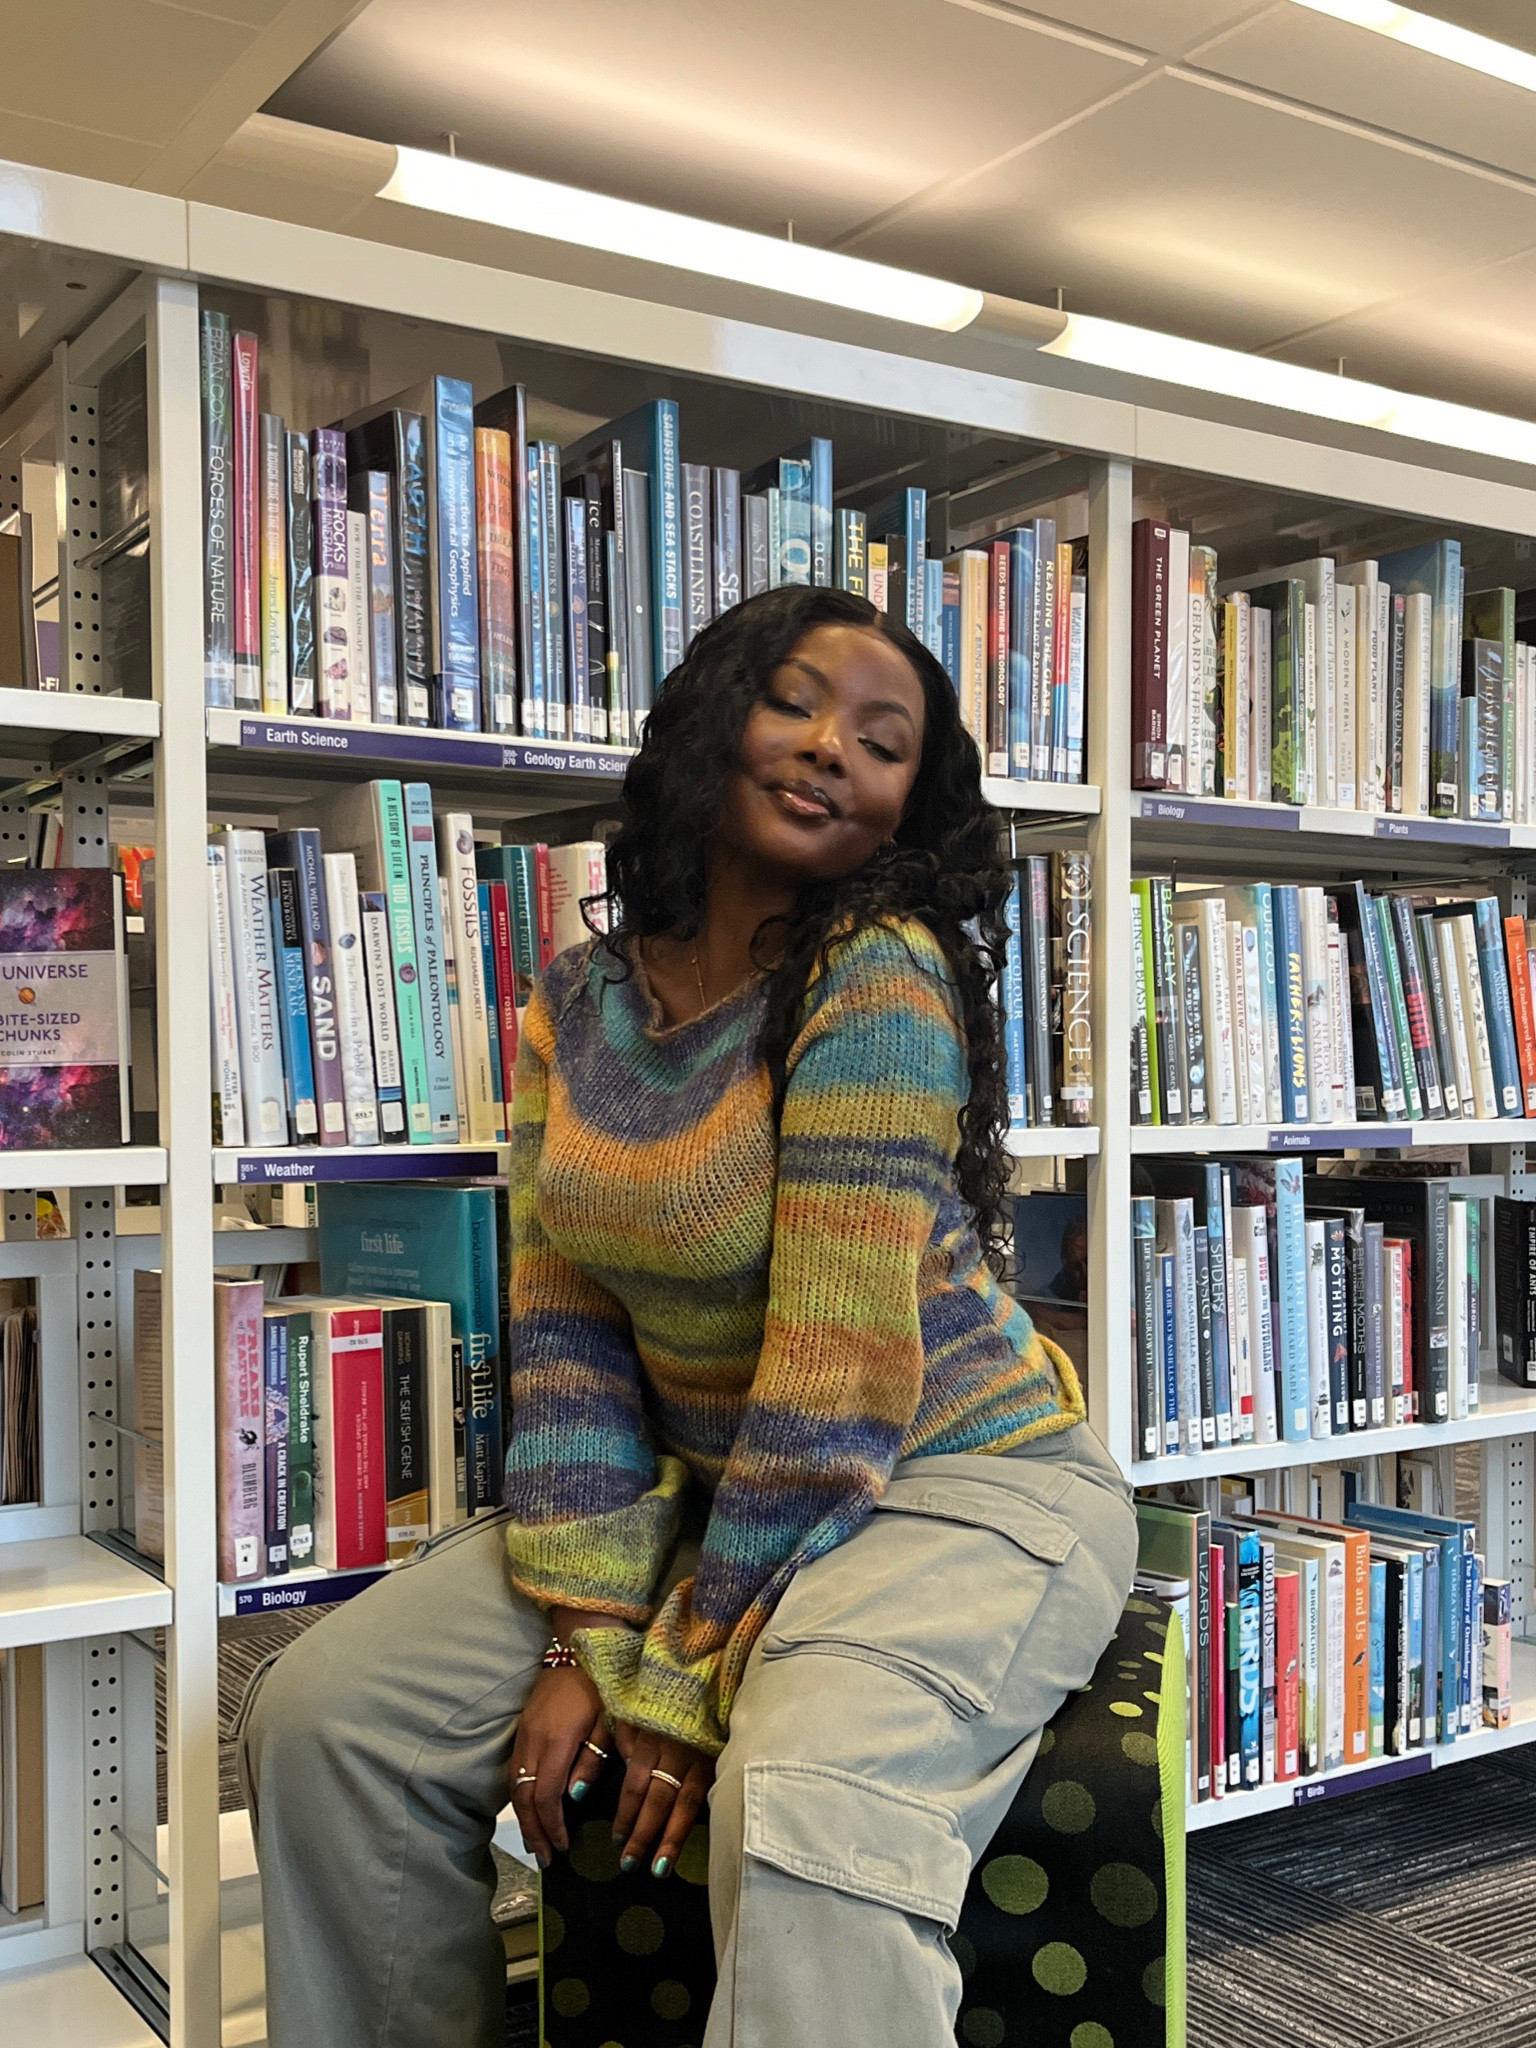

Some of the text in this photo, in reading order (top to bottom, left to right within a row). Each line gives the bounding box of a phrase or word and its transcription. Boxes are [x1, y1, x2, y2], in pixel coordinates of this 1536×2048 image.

[210, 327, 223, 423] BRIAN COX
[241, 352, 252, 390] Lowrie
[211, 445, 225, 624] FORCES OF NATURE
[322, 506, 333, 569] MINERALS
[333, 508, 346, 563] ROCKS
[370, 487, 387, 566] Terra
[448, 459, 459, 546] Environmental
[459, 434, 472, 596] An Introduction to Applied
[589, 500, 602, 528] ice
[663, 413, 677, 599] SANDSTONE AND SEA STACKS
[447, 550, 460, 617] Geophysics
[689, 491, 705, 614] COASTLINES
[848, 523, 864, 568] THE
[915, 539, 925, 622] THE WEATHER
[1031, 558, 1042, 714] CAPTAIN ELLIOT RAPPAPORT
[1042, 560, 1055, 717] READING THE GLASS
[1070, 607, 1082, 694] WAKING THE GIANT
[1153, 557, 1163, 679] THE GREEN PLANET
[998, 634, 1006, 706] METEOROLOGY
[1393, 623, 1405, 747] DEATH GARDEN
[266, 729, 298, 744] Earth
[301, 733, 348, 748] Science
[524, 752, 566, 769] Geology
[569, 755, 596, 769] Earth
[1150, 709, 1158, 741] BARNES
[387, 804, 399, 837] HISTORY
[389, 839, 399, 850] OF
[1157, 804, 1184, 818] Biology
[1389, 823, 1407, 834] Plants
[391, 851, 401, 868] LIFE
[392, 884, 409, 904] 100
[394, 870, 403, 879] IN
[250, 875, 275, 1051] WEATHER MATTERS
[306, 844, 337, 1062] MICHAEL WELLAND SAND
[394, 908, 412, 954] FOSSILS
[420, 854, 445, 1060] PRINCIPLES of PALEONTOLOGY
[461, 866, 483, 1021] FOSSILS RICHARD FORTEY
[499, 911, 512, 1031] BRITISH MESOZOIC FOSSILS
[518, 925, 532, 970] Fortey
[1160, 887, 1176, 987] BEASTLY
[2, 964, 88, 980] UNIVERSE
[370, 916, 390, 1042] DARWIN'S LOST WORLD
[482, 910, 490, 946] BRITISH
[488, 1005, 497, 1040] FOSSILS
[1036, 937, 1048, 1032] David Attenborough
[1066, 911, 1092, 1062] SCIENCE
[1234, 937, 1245, 1029] ANIMAL REVIEW
[1431, 957, 1448, 1036] Built by Animals
[1140, 1028, 1148, 1062] CHARLES
[1312, 1019, 1323, 1089] ANIMALS
[1516, 953, 1535, 1077] Atlas Endangered Species
[1400, 1041, 1413, 1085] Colwell
[264, 1164, 314, 1176] Weather
[1283, 1136, 1310, 1145] Animals
[361, 1231, 404, 1254] first life
[1210, 1242, 1226, 1313] SPIDERS
[1434, 1197, 1446, 1316] SUPERORGANISM
[1528, 1226, 1536, 1256] EMPIRE
[1528, 1259, 1536, 1270] OF
[1143, 1241, 1154, 1365] LIFE UNDERGROWTH
[1238, 1267, 1249, 1317] Insects
[1258, 1256, 1273, 1373] BUGS VICTORIANS
[1283, 1203, 1298, 1402] PETER MARREN & RICHARD MABEY
[1331, 1246, 1344, 1337] MOTHING
[1528, 1273, 1536, 1296] ANTS
[248, 1317, 260, 1419] FREAKS
[297, 1336, 310, 1444] Rupert Sheldrake
[469, 1332, 496, 1420] first life
[399, 1374, 412, 1480] THE SELFISH GENE
[473, 1433, 487, 1499] Matt Kaplan
[242, 1462, 258, 1510] BLUMBERG
[456, 1457, 466, 1493] DARWIN
[239, 1590, 306, 1606] 570 Biology
[1198, 1551, 1209, 1647] LIZARDS
[1263, 1553, 1275, 1647] 100 BIRDS
[1355, 1544, 1368, 1641] Birds and Us
[1462, 1557, 1474, 1680] The History of Ornithology
[1238, 1608, 1259, 1717] BIRDS
[1307, 1785, 1325, 1798] Birds
